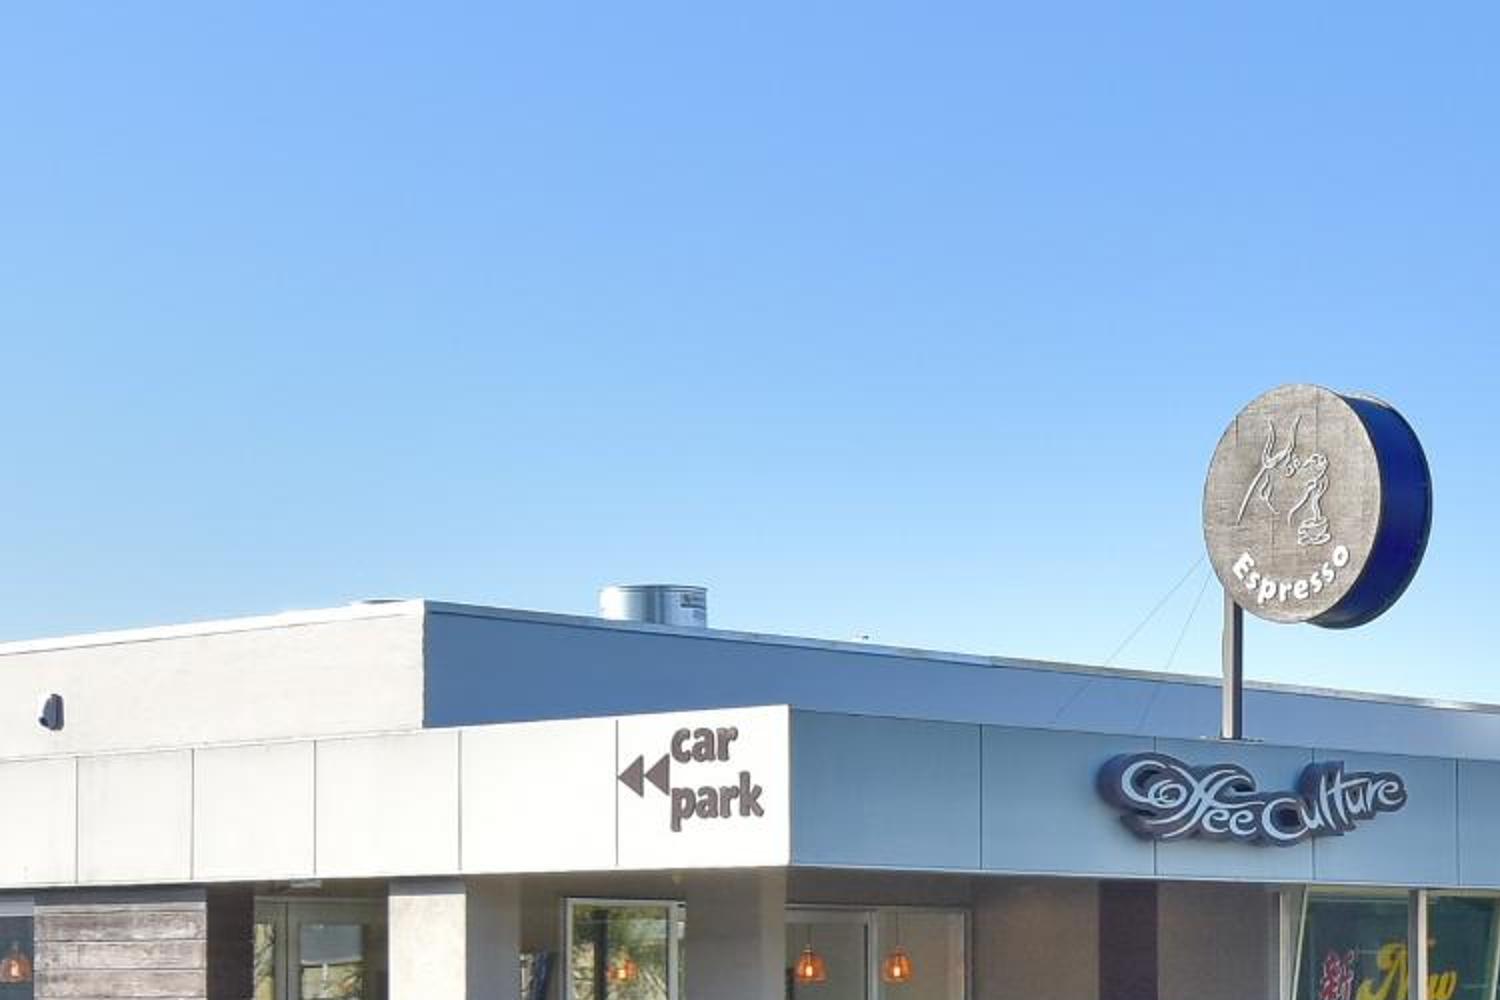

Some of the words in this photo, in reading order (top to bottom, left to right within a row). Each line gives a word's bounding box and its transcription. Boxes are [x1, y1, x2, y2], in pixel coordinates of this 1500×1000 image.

[1232, 545, 1350, 604] Espresso
[670, 726, 739, 763] car
[670, 770, 765, 833] park
[1120, 759, 1265, 838] Coffee
[1260, 767, 1406, 841] Culture
